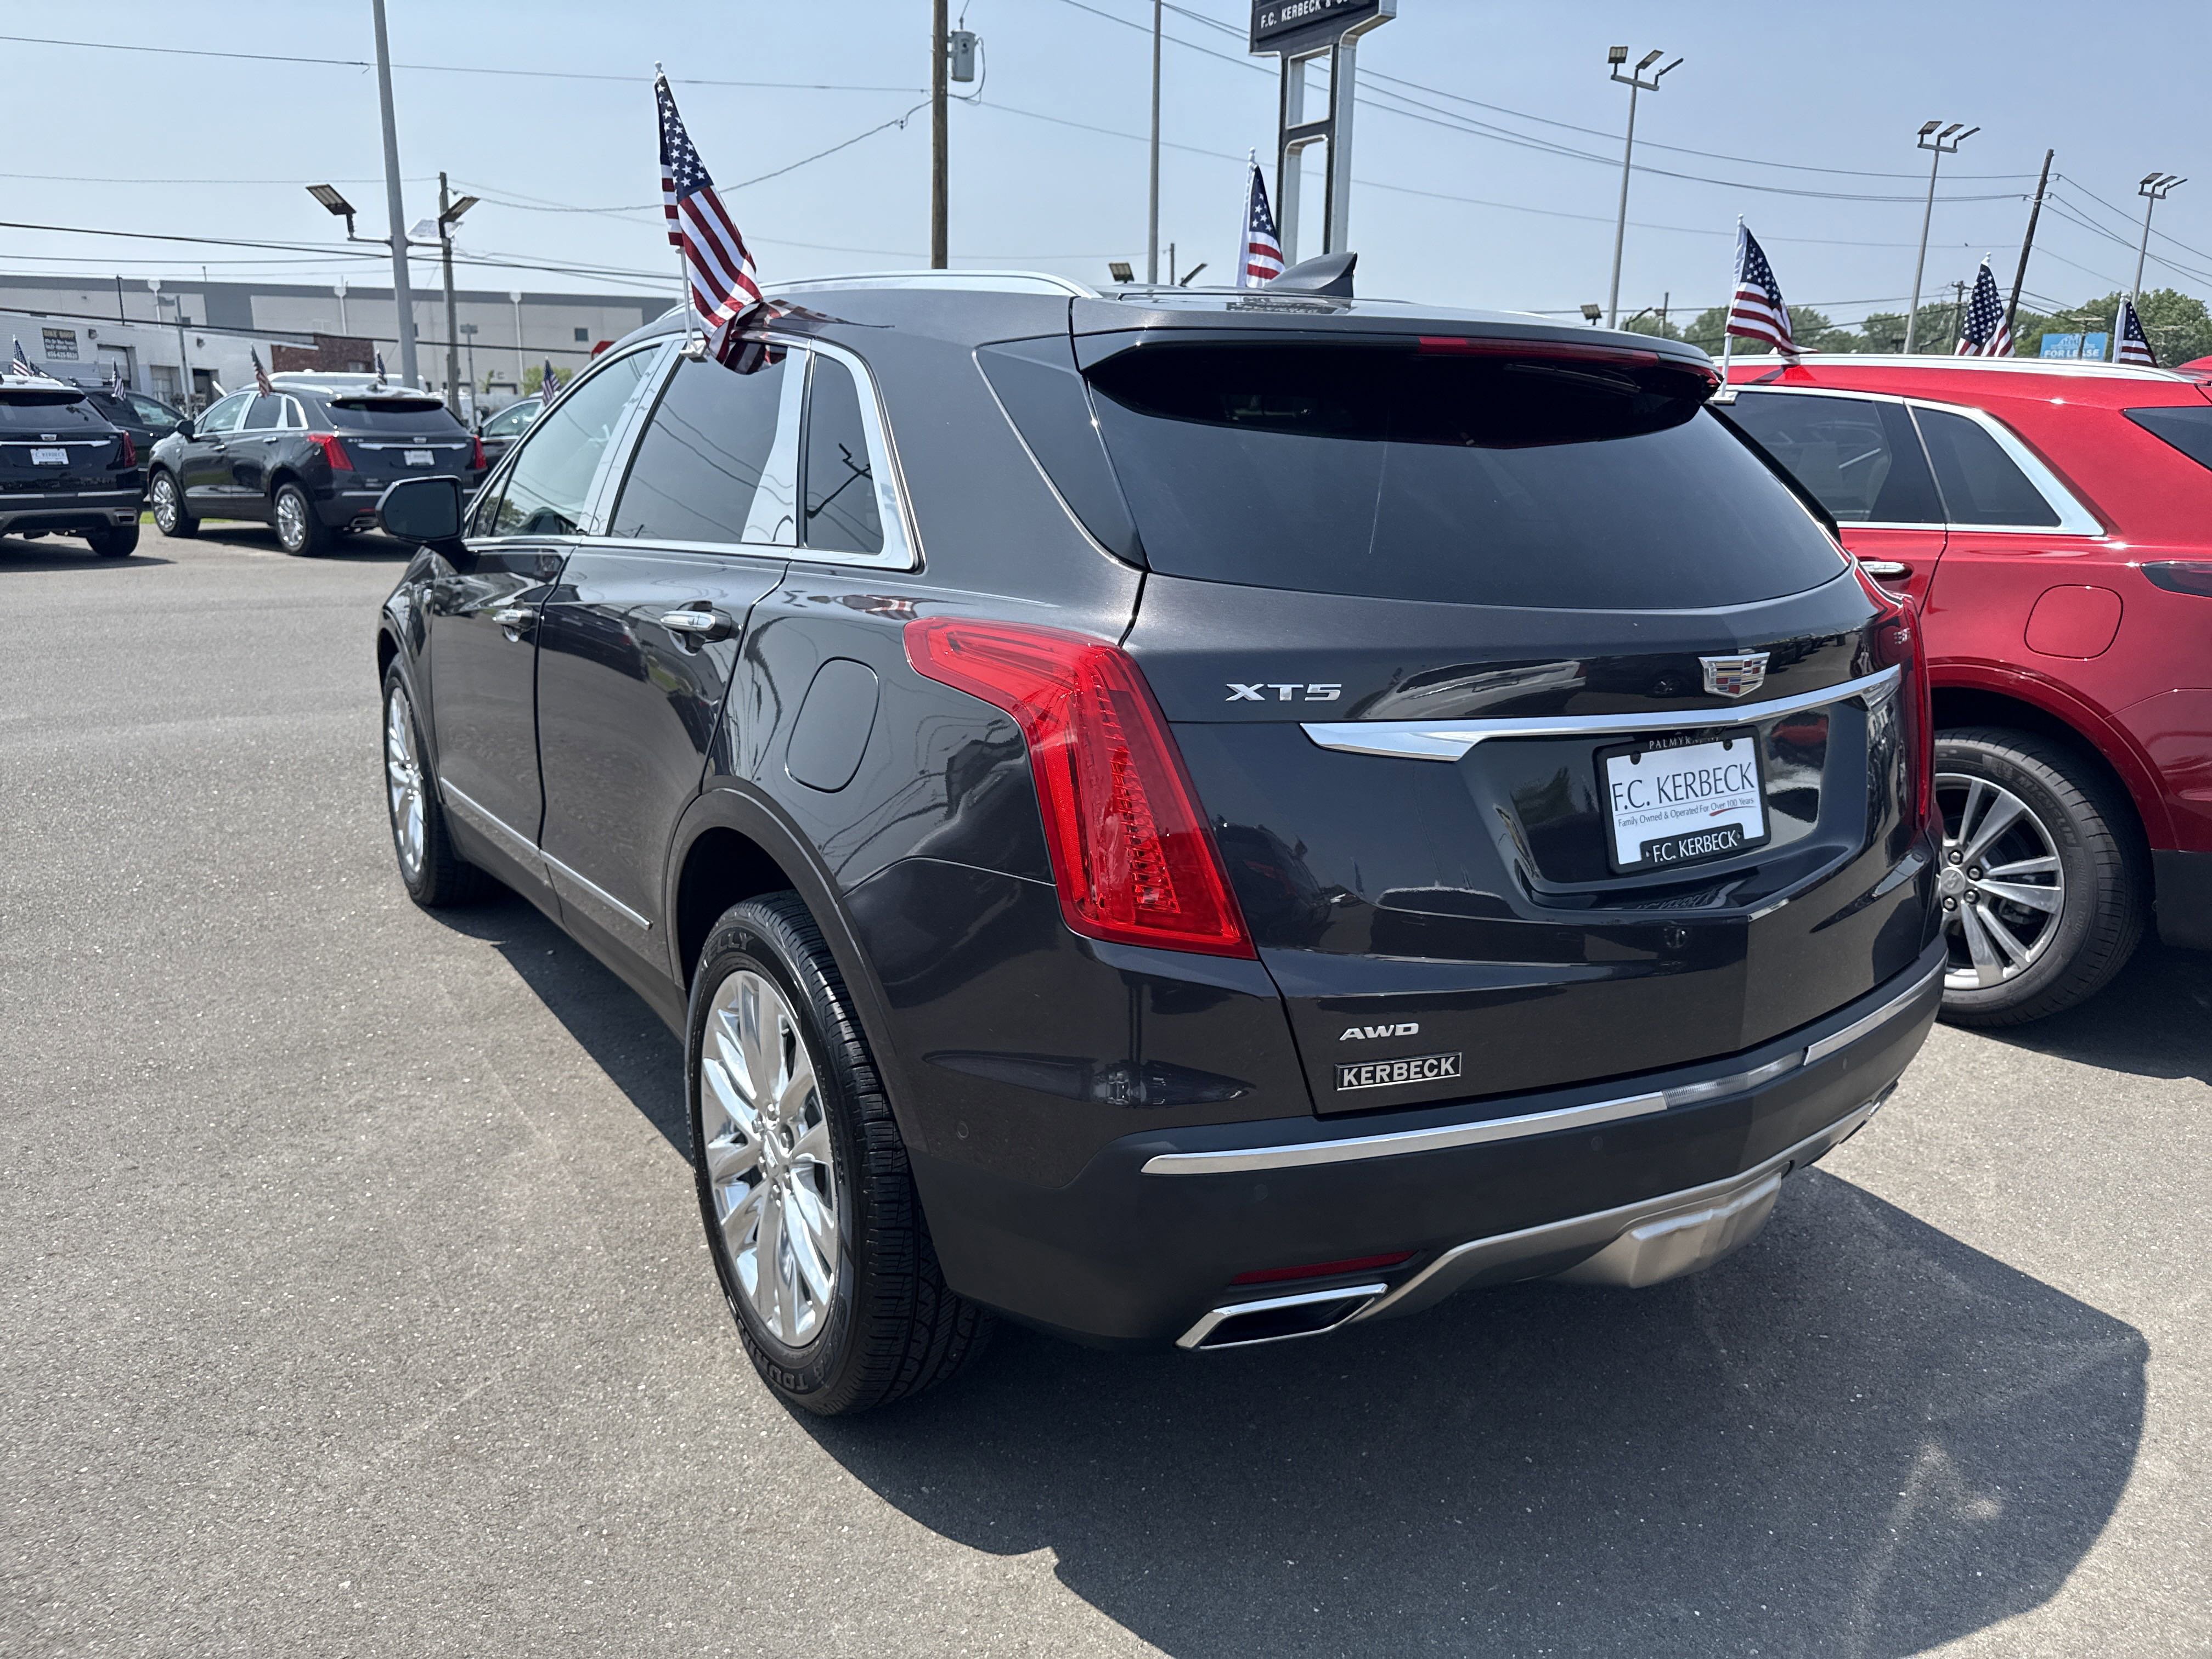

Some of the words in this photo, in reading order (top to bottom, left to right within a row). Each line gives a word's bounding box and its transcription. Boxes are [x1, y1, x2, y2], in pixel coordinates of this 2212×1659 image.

[1261, 12, 1277, 29] F.C.
[1282, 0, 1322, 22] KERBECK
[2044, 349, 2064, 358] FOR
[2067, 349, 2100, 358] LESE
[1225, 684, 1342, 701] XT5
[1612, 779, 1650, 811] F.C.
[1656, 762, 1754, 804] KERBECK
[1618, 816, 1638, 827] Family
[1639, 811, 1662, 823] Owned
[1664, 811, 1669, 820] &
[1670, 805, 1699, 819] Operated
[1700, 805, 1709, 814] For
[1711, 802, 1725, 811] Over
[1727, 799, 1737, 808] 100
[1739, 797, 1754, 805] Years
[1652, 842, 1677, 863] F.C.
[1678, 830, 1738, 858] KERBECK
[1339, 1023, 1419, 1041] AWD
[1343, 1057, 1455, 1087] KERBECK
